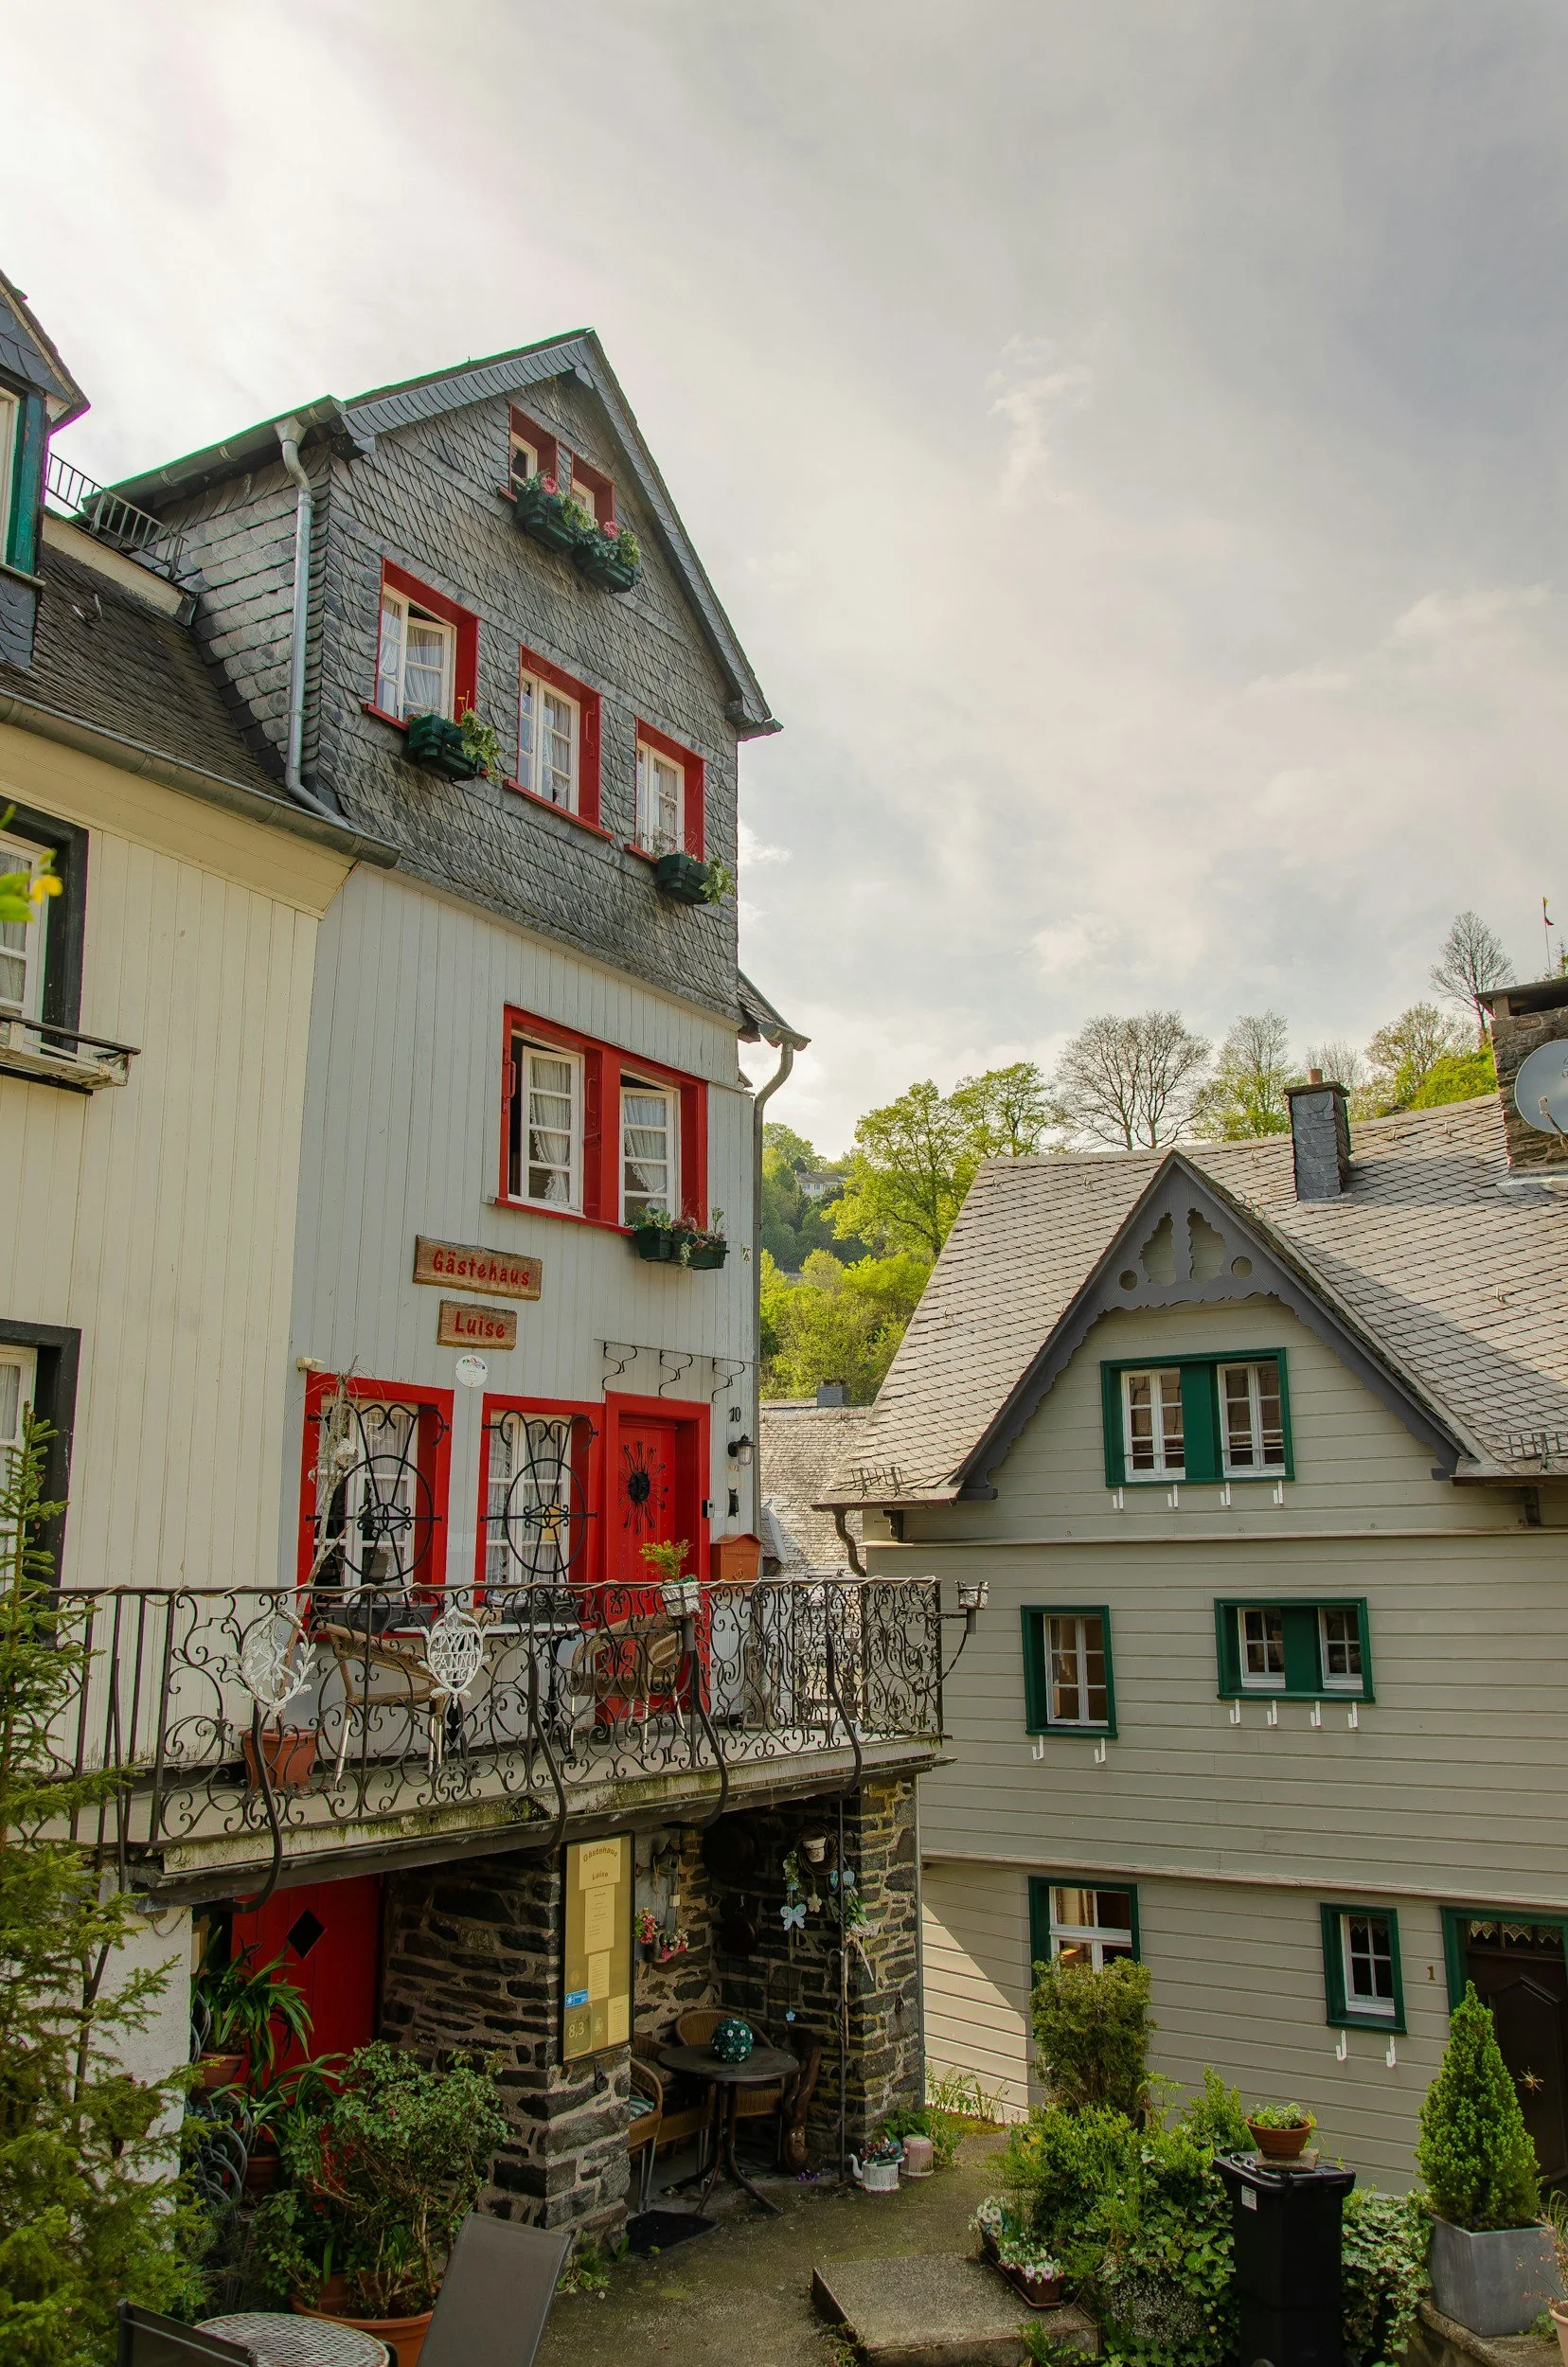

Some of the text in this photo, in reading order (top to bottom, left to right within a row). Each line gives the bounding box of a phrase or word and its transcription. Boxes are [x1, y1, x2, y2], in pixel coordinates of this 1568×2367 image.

[433, 1250, 530, 1288] Gästehaus
[454, 1310, 505, 1339] Luise
[728, 1406, 741, 1423] 10
[1427, 1966, 1436, 1981] 1
[569, 2021, 585, 2038] 8,3
